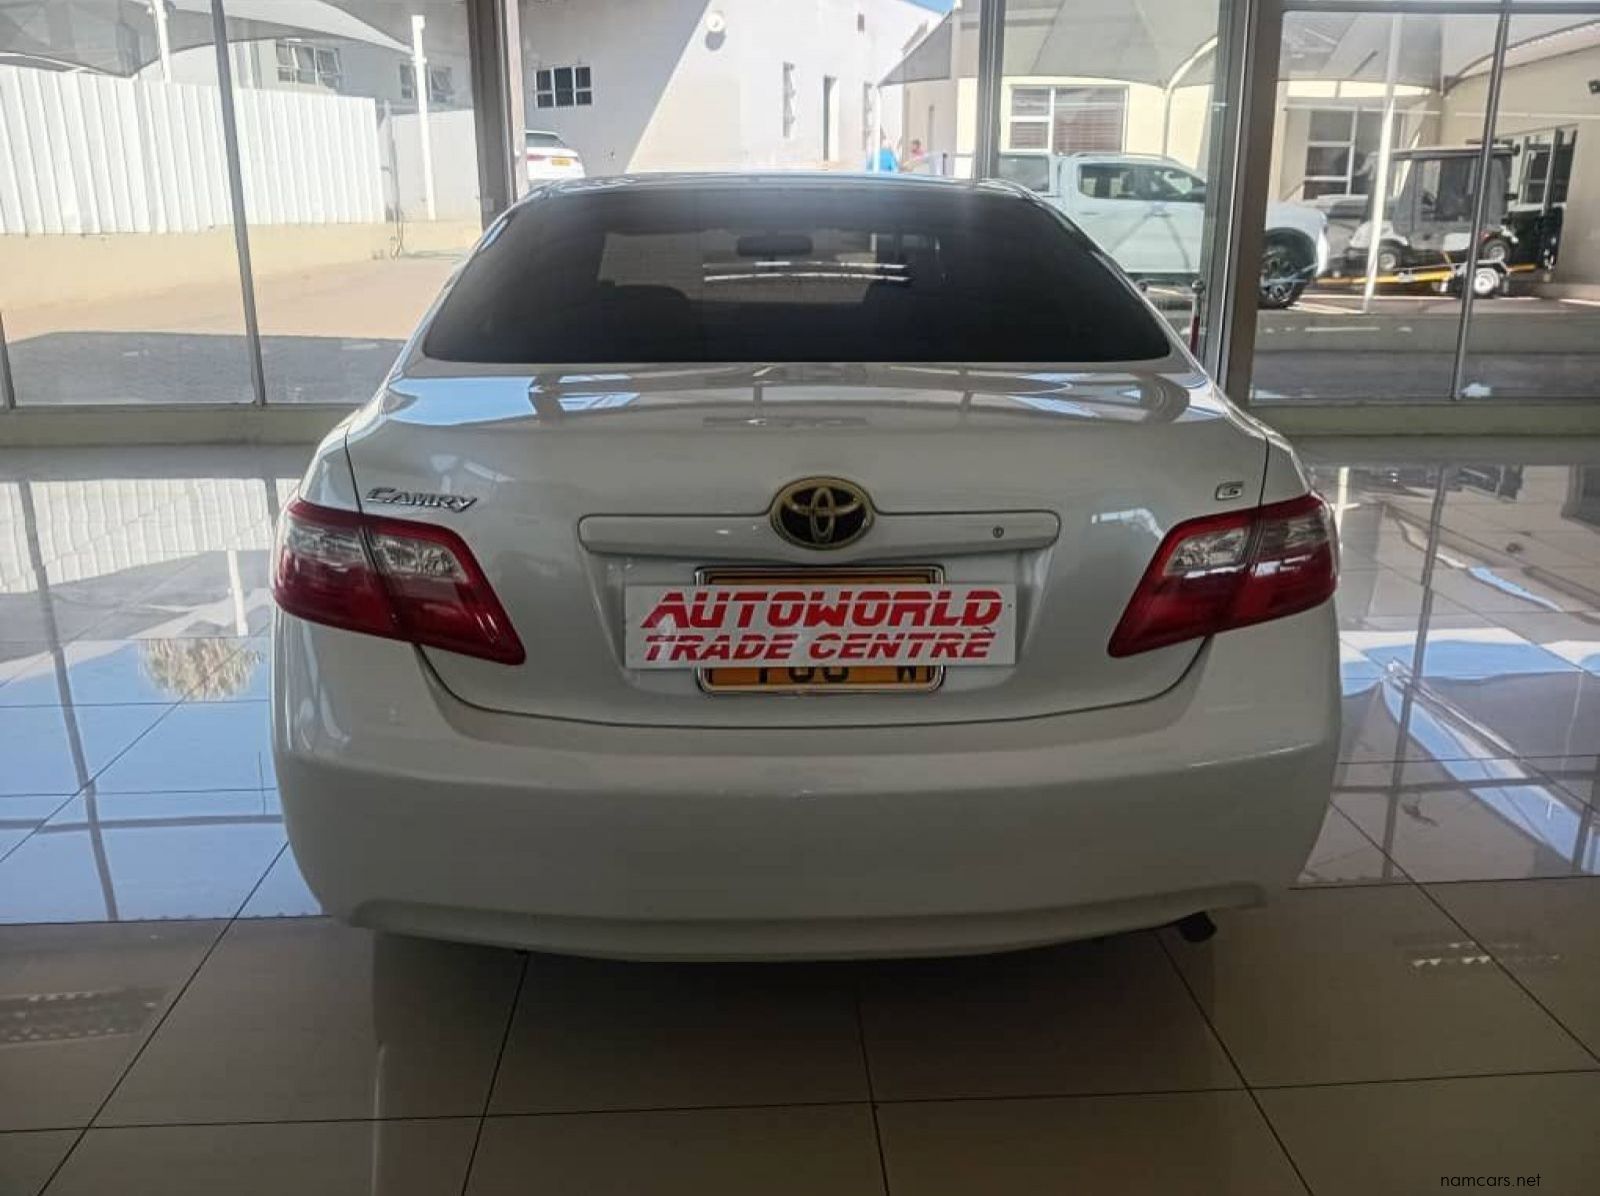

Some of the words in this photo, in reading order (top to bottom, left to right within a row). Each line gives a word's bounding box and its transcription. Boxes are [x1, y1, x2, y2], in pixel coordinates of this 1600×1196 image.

[365, 487, 477, 513] CAMRY
[640, 590, 1003, 629] AUTOWORLD
[645, 633, 799, 661] TRADE
[808, 631, 997, 659] CENTRE
